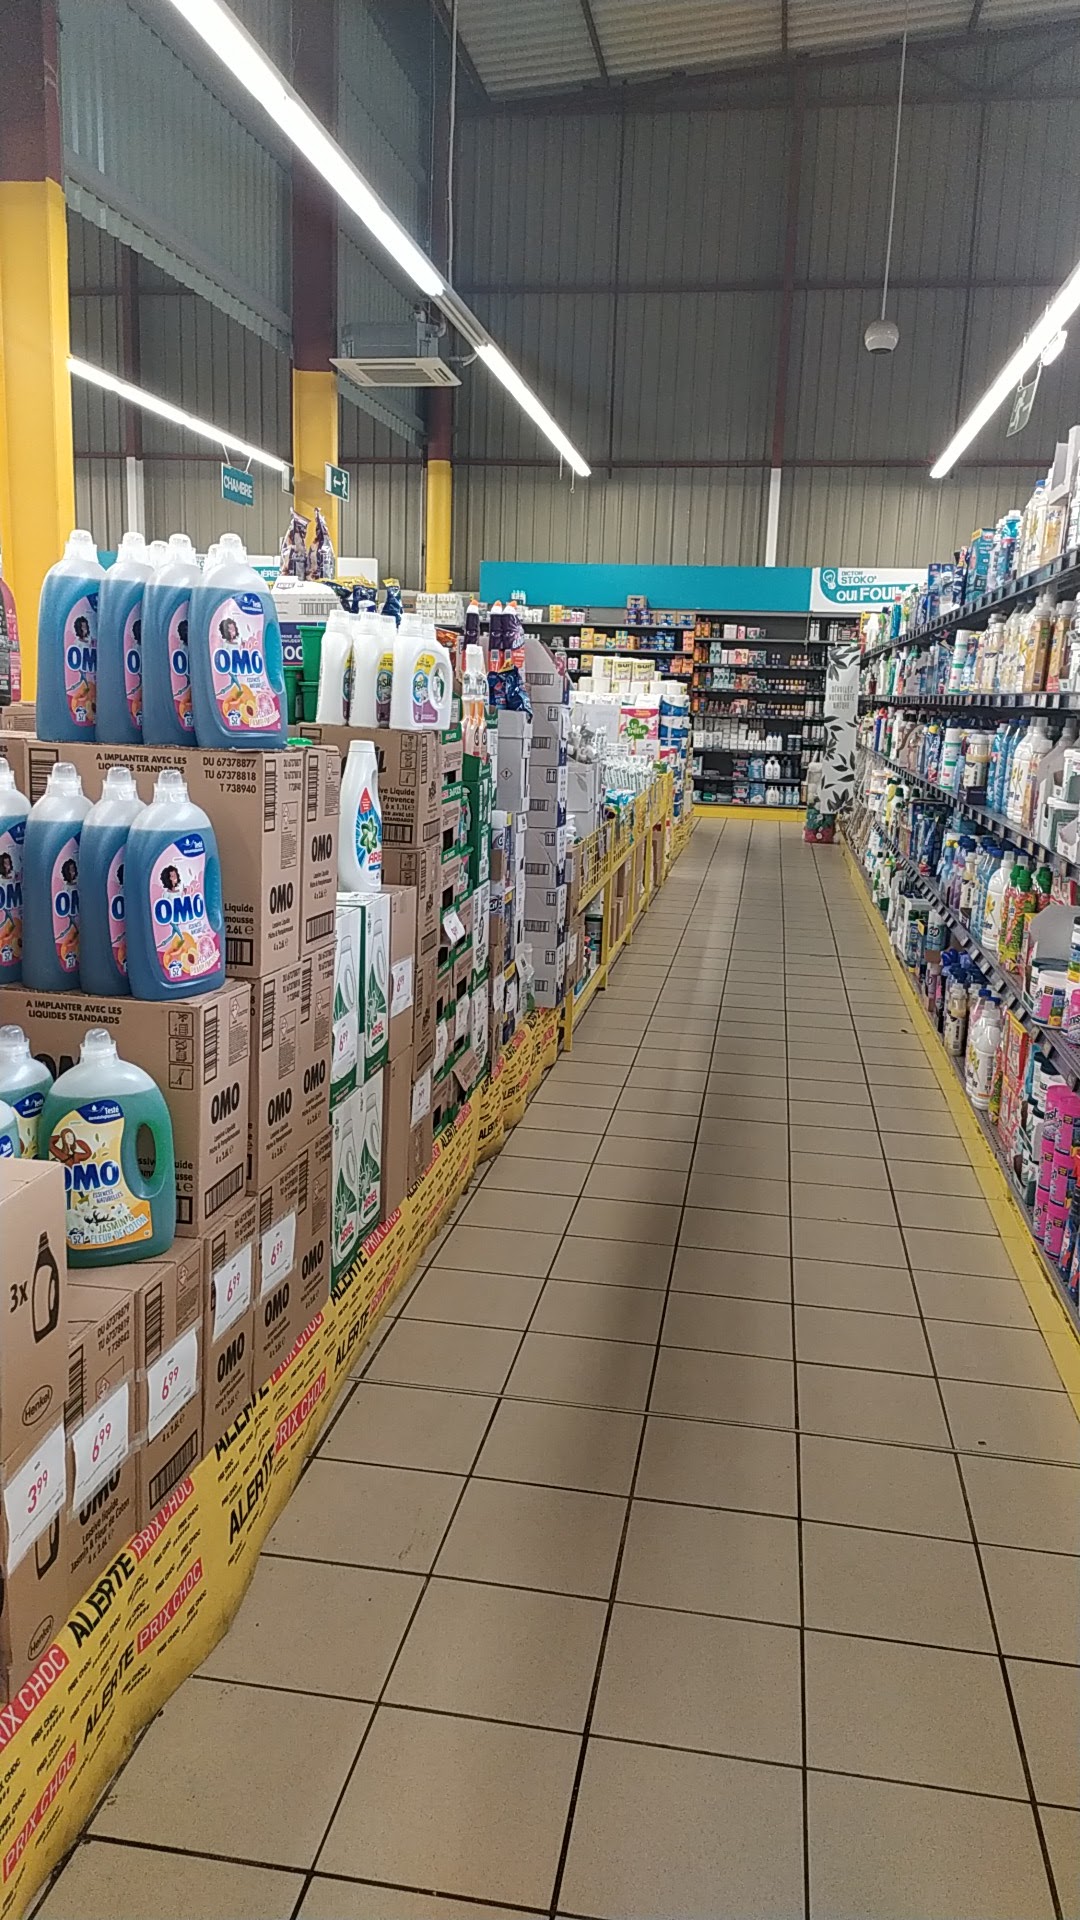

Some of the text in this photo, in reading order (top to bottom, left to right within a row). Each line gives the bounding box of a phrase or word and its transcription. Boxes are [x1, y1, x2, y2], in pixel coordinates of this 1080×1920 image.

[223, 475, 253, 498] CHAMBRE
[836, 589, 858, 601] QUI
[67, 646, 98, 672] OM
[213, 648, 263, 675] OMO
[230, 716, 239, 725] 52
[104, 753, 149, 763] IMPLANTER
[151, 755, 172, 764] AVEC
[174, 756, 187, 765] LES
[202, 757, 257, 769] DU 67378877
[204, 770, 257, 781] TU 67378818
[219, 783, 257, 794] T 738940
[383, 796, 414, 804] Provence
[390, 788, 415, 797] Liquide
[311, 833, 332, 862] OMO
[368, 852, 382, 864] ARIE
[155, 894, 204, 924] OMO
[224, 903, 254, 913] Liquide
[269, 882, 294, 914] OMO
[224, 916, 254, 924] mousse
[172, 967, 180, 976] 52
[25, 1000, 122, 1015] A IMPLANTER AVEC LES
[28, 1010, 120, 1024] LIQUIDES STANDARDS
[304, 1059, 326, 1094] OMO
[104, 1105, 119, 1114] Testé
[211, 1082, 240, 1124] OMO
[267, 1088, 292, 1126] OMO
[174, 1160, 193, 1169] uide
[90, 1233, 112, 1245] FLEUR
[125, 1216, 147, 1235] COTON
[98, 1219, 127, 1234] JASMIN
[72, 1235, 81, 1244] 52
[302, 1240, 324, 1280] OMO
[9, 1281, 29, 1314] 3x
[264, 1282, 290, 1328] OMO
[97, 1324, 106, 1338] DU
[334, 1305, 370, 1373] ALERTE
[216, 1331, 245, 1383] OMO
[24, 1388, 50, 1421] Henkel
[300, 1372, 326, 1420] CHOC
[229, 1442, 275, 1545] ALERTE
[187, 1504, 200, 1520] CHOC
[82, 1518, 101, 1545] Lessive
[132, 1519, 163, 1559] PRIX
[189, 1528, 202, 1544] CHOC
[161, 1538, 172, 1555] CHOC
[164, 1563, 176, 1580] CHOC
[67, 1551, 136, 1649] ALERTE
[139, 1561, 202, 1650] PRIX CHOC
[78, 1657, 92, 1680] CHOC
[0, 1648, 66, 1745] IX CHOC
[83, 1640, 136, 1746] ALERTE
[43, 1704, 60, 1730] CHOC
[4, 1757, 21, 1782] CHOC
[5, 1747, 76, 1876] PRIX CHOC
[11, 1788, 27, 1815] CHOC
